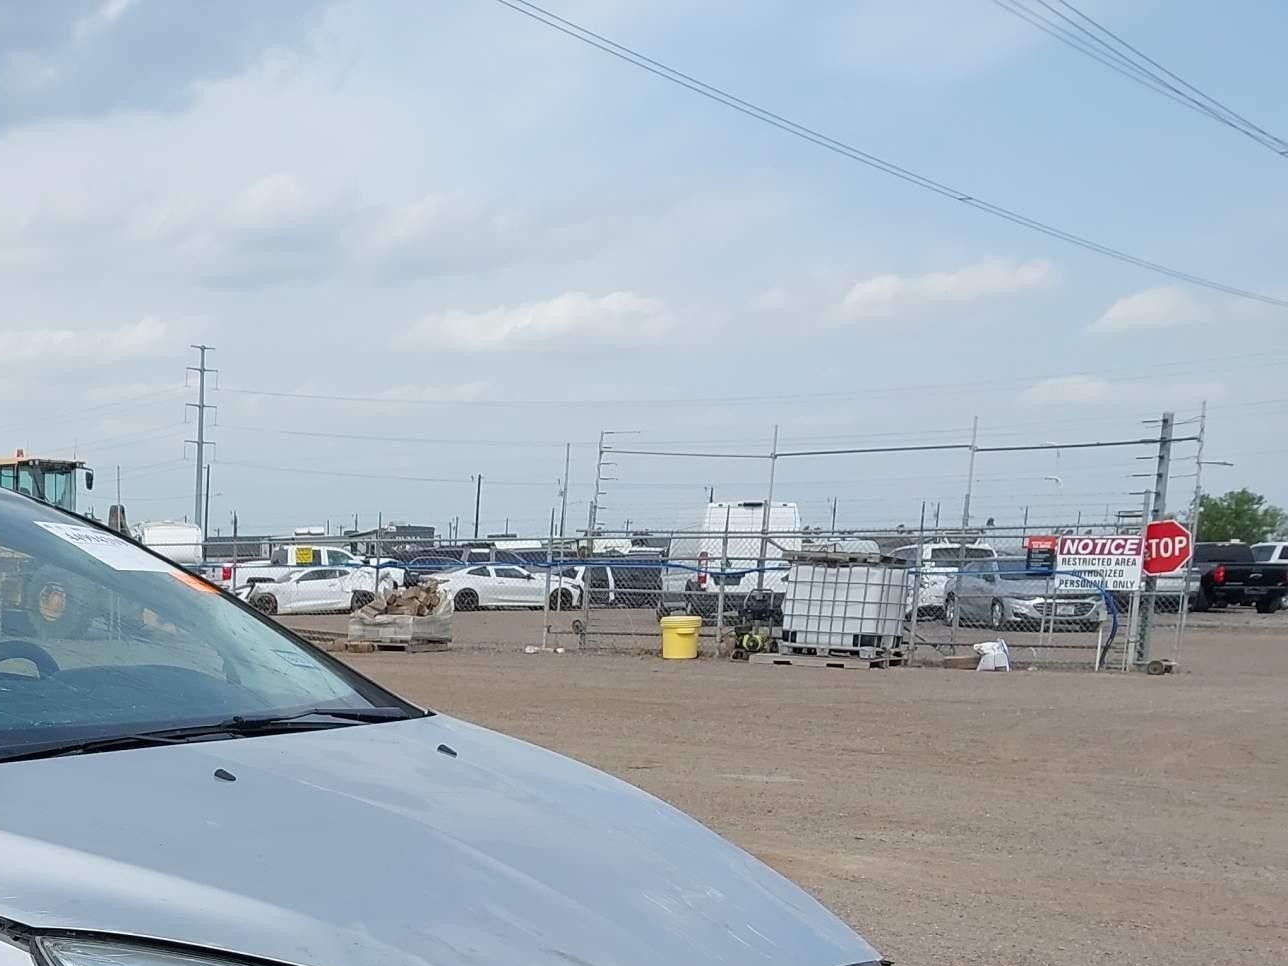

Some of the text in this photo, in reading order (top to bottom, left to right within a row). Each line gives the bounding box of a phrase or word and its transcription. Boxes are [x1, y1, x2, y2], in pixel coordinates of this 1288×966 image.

[1062, 539, 1140, 555] NOTICE
[1061, 557, 1137, 566] RESTRICTED AREA
[1112, 580, 1135, 589] ONLY
